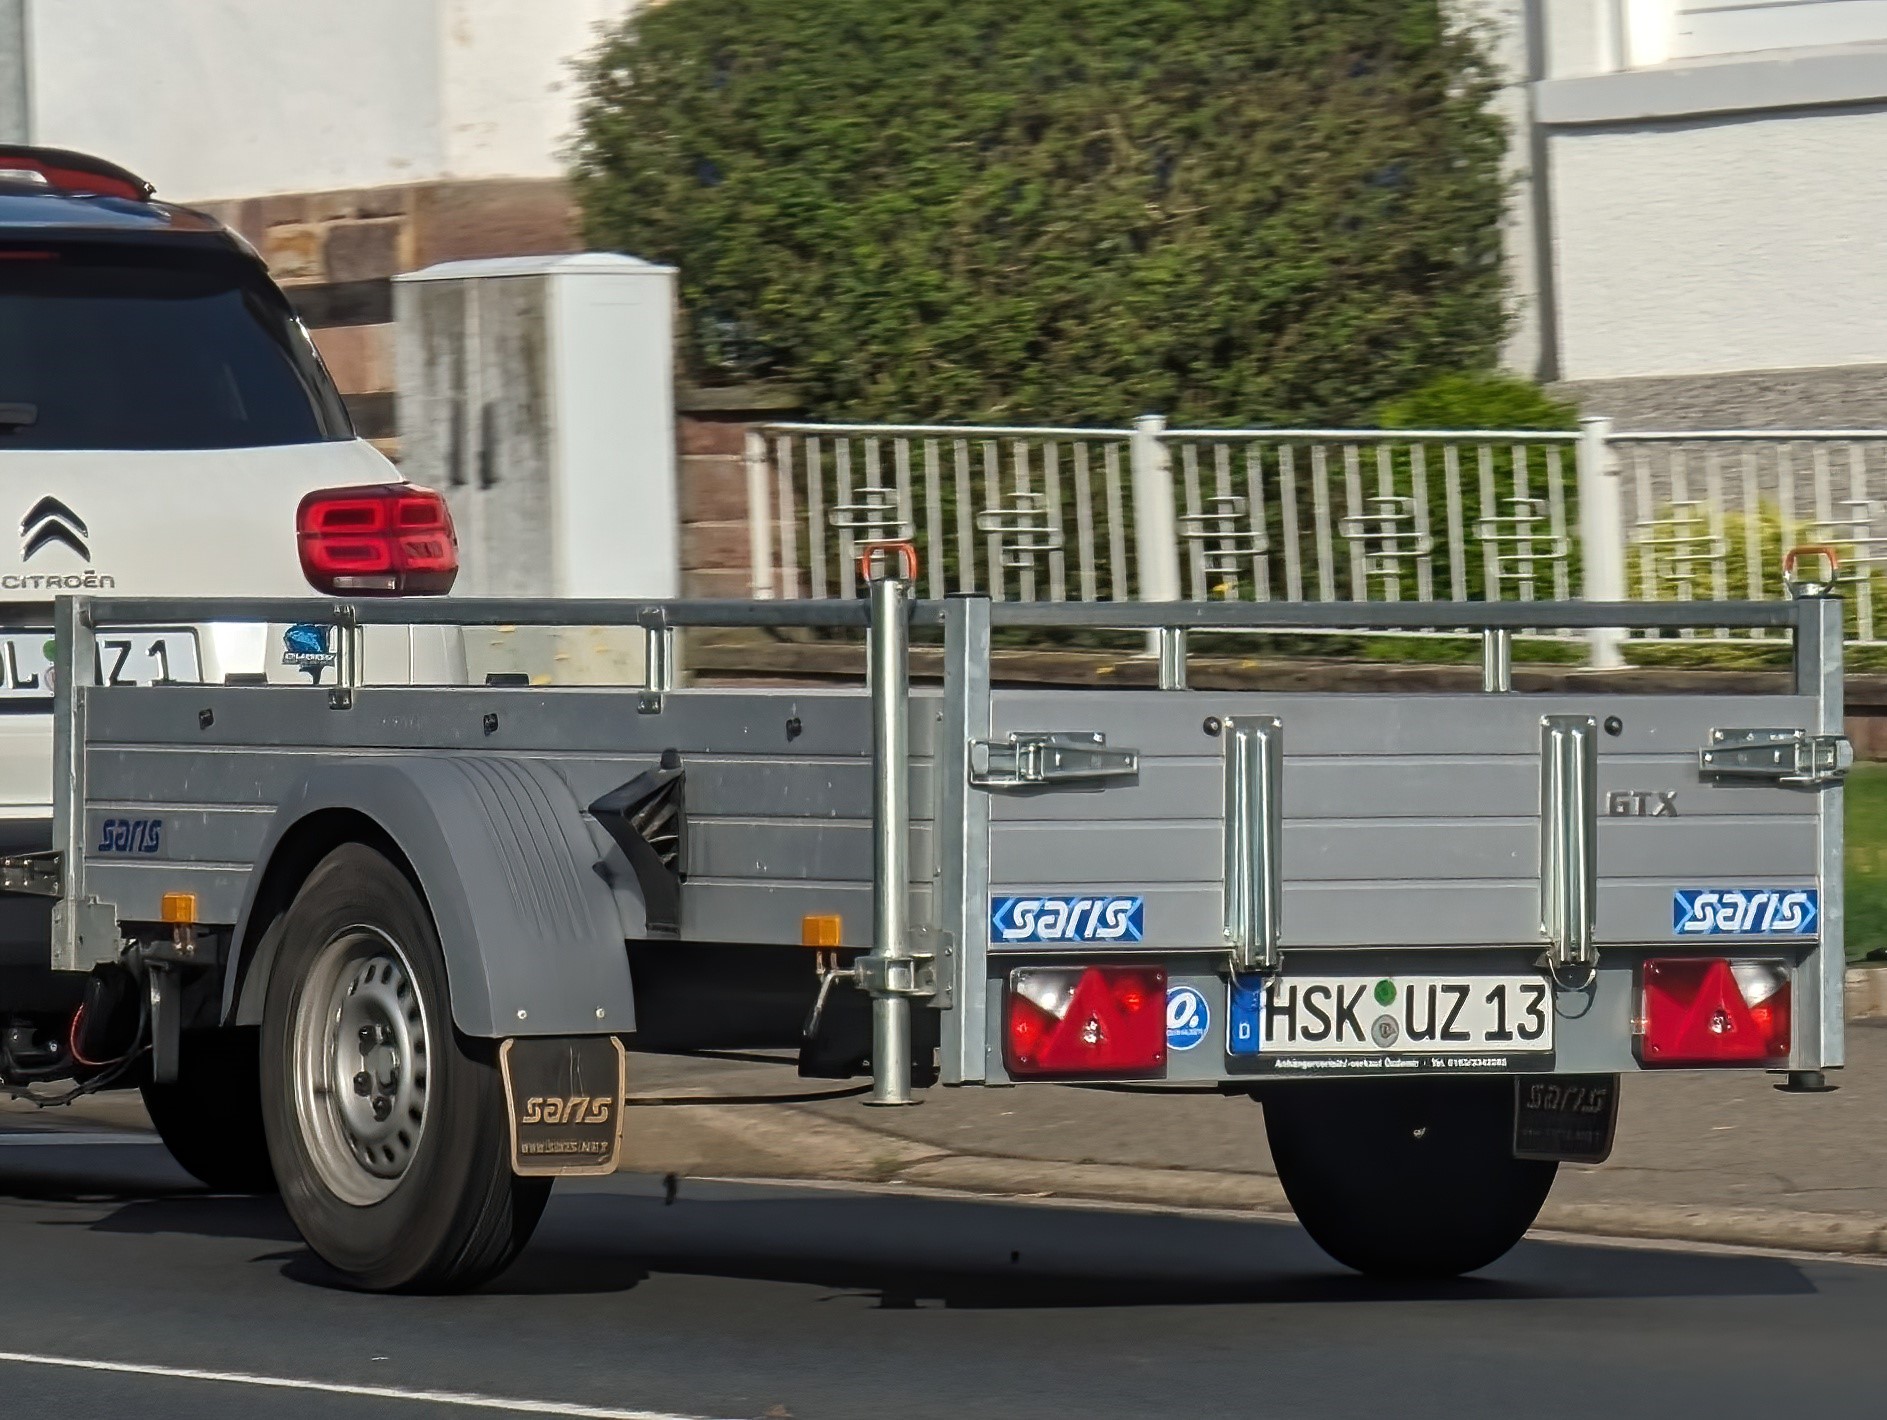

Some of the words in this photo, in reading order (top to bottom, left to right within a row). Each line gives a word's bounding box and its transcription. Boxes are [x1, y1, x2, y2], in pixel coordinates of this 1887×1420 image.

[0, 640, 39, 689] L
[1606, 790, 1678, 817] GTX
[98, 819, 162, 852] saris
[1002, 899, 1133, 939] saris
[1683, 893, 1808, 931] saris
[1265, 984, 1368, 1042] HSK
[1405, 984, 1471, 1042] UZ
[1484, 984, 1547, 1042] 13
[1238, 1022, 1251, 1040] D
[522, 1097, 612, 1124] saris
